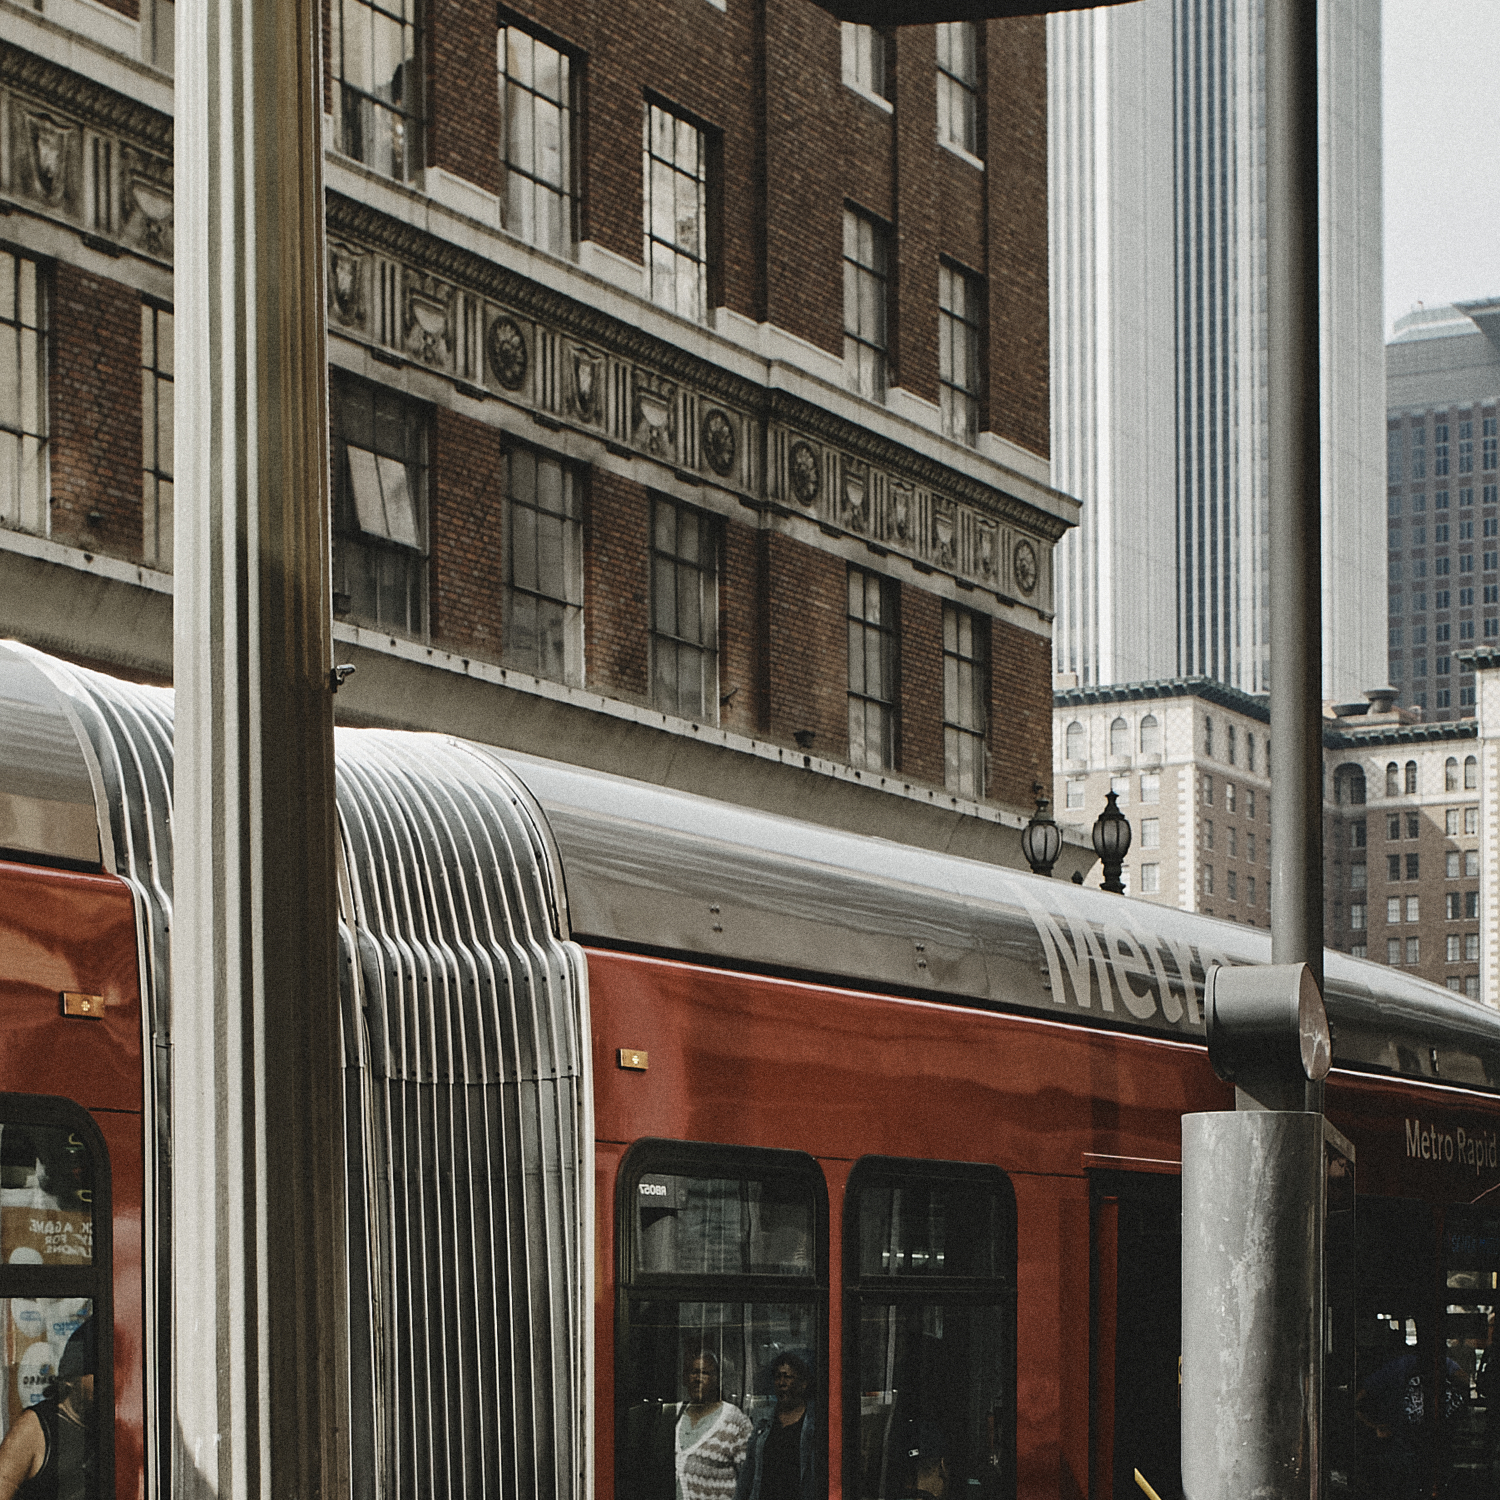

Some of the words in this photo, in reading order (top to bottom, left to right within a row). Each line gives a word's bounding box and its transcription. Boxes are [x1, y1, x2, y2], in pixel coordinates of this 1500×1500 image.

[1008, 880, 1234, 1024] Metr
[1404, 1117, 1455, 1163] Metro
[1456, 1125, 1499, 1177] Rapid
